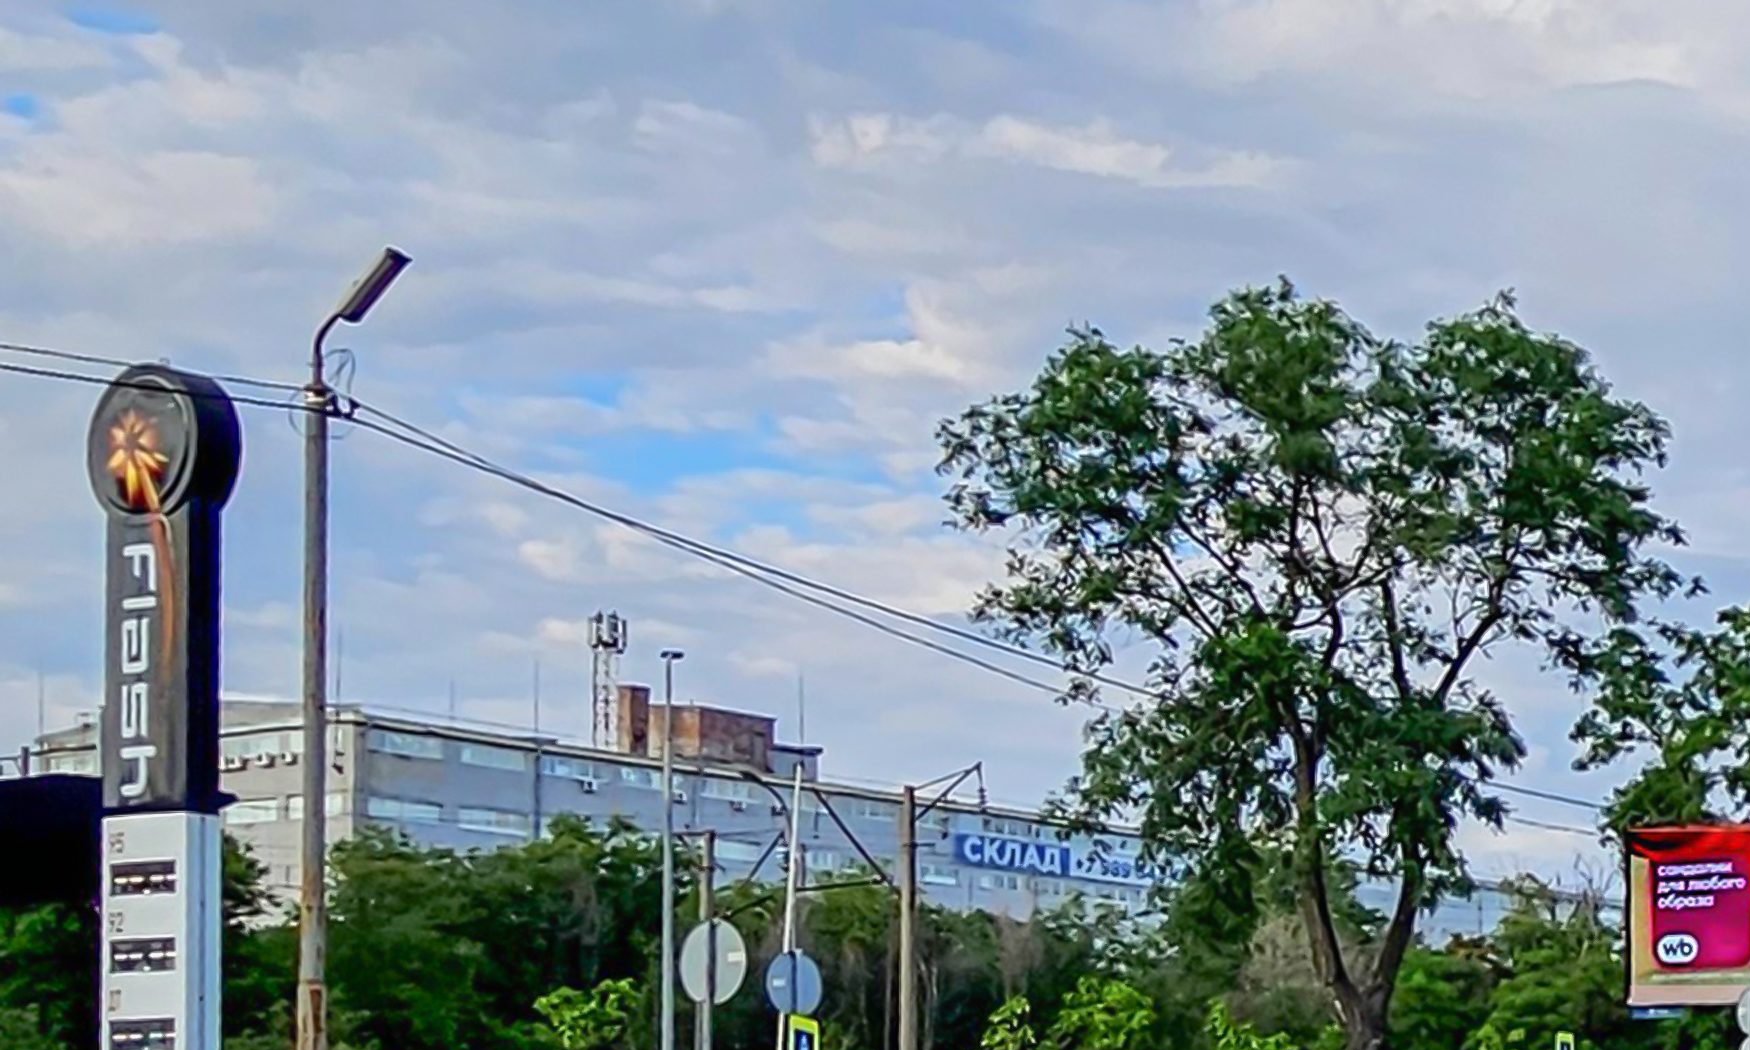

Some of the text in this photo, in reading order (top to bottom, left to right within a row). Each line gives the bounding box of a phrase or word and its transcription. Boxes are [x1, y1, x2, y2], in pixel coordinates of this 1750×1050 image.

[963, 835, 1061, 875] СКЛАД
[1687, 875, 1747, 891] любого
[1657, 893, 1715, 911] образа
[1662, 937, 1694, 957] wb
